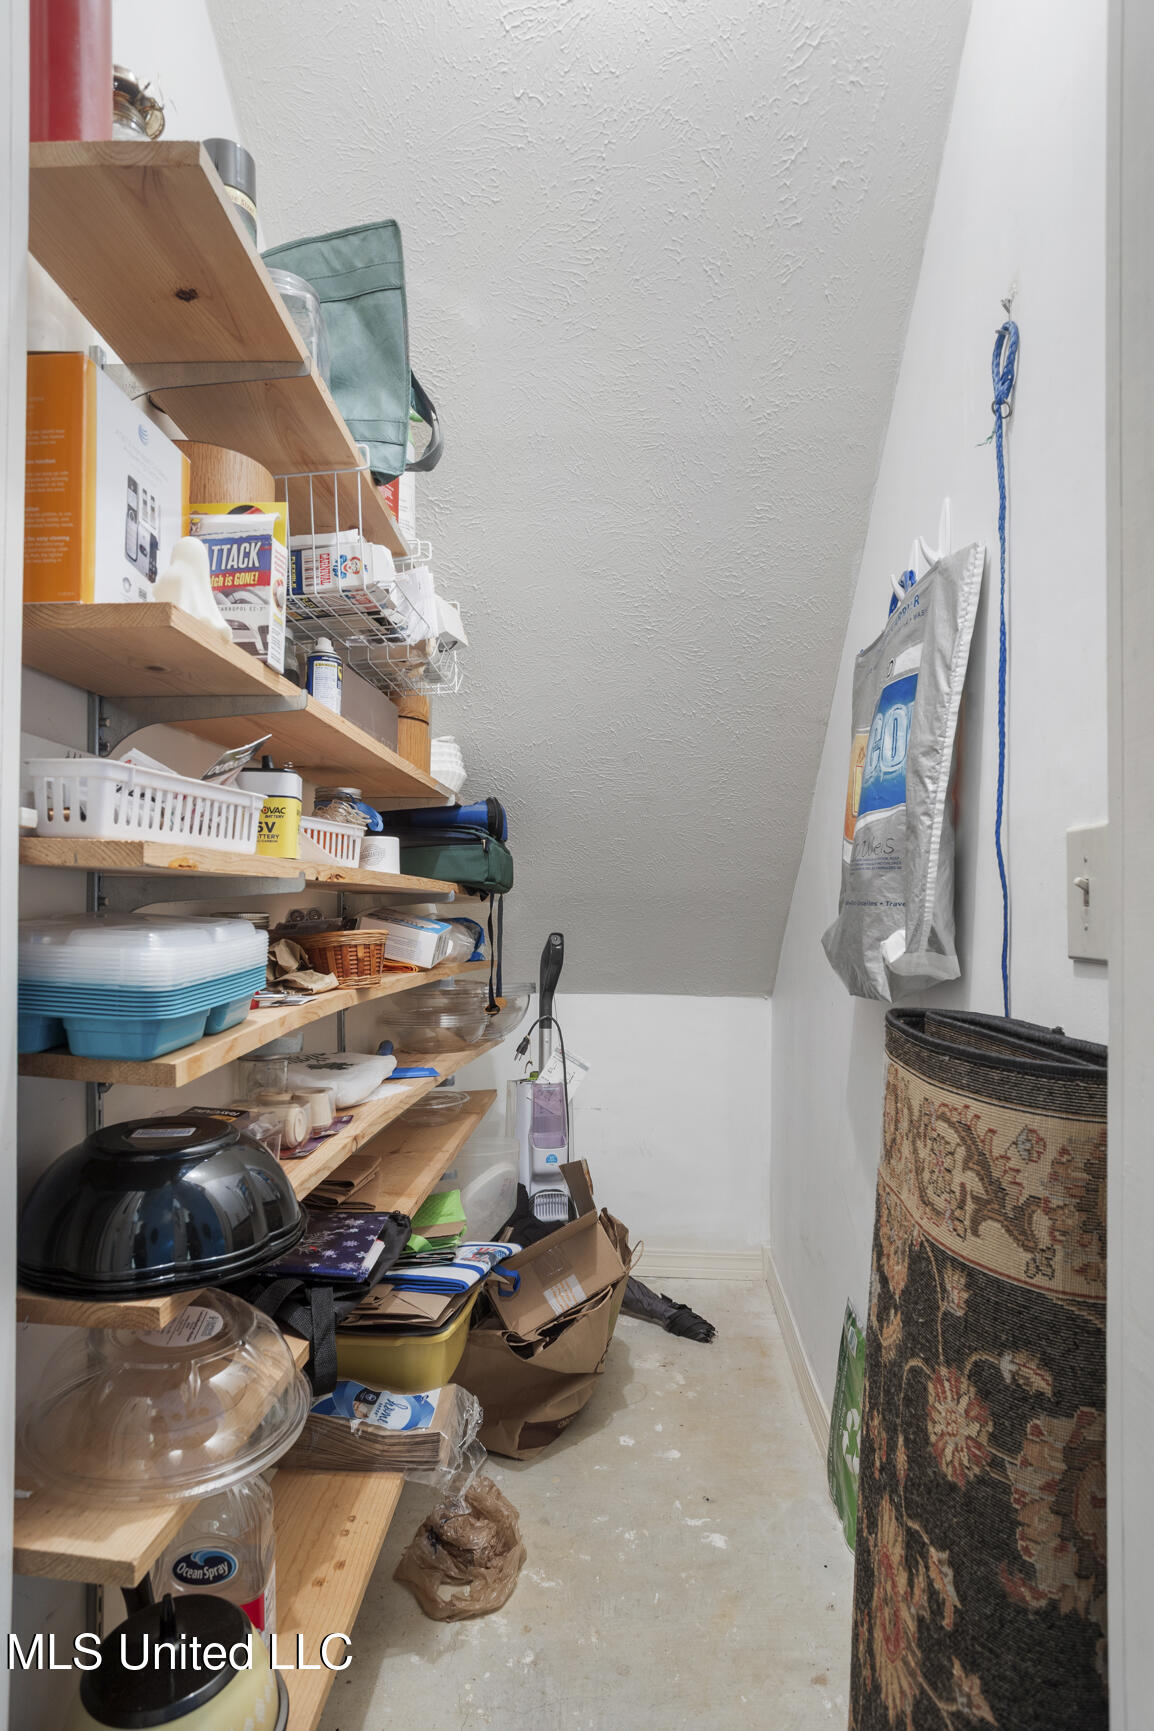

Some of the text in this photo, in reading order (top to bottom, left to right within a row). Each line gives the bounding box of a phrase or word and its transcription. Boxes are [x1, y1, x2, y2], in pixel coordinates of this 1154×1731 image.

[319, 553, 332, 585] CARNIVAL
[225, 573, 233, 586] is
[233, 571, 259, 585] GONE!
[261, 806, 287, 814] OVAC
[177, 1561, 229, 1581] Ocean Spray
